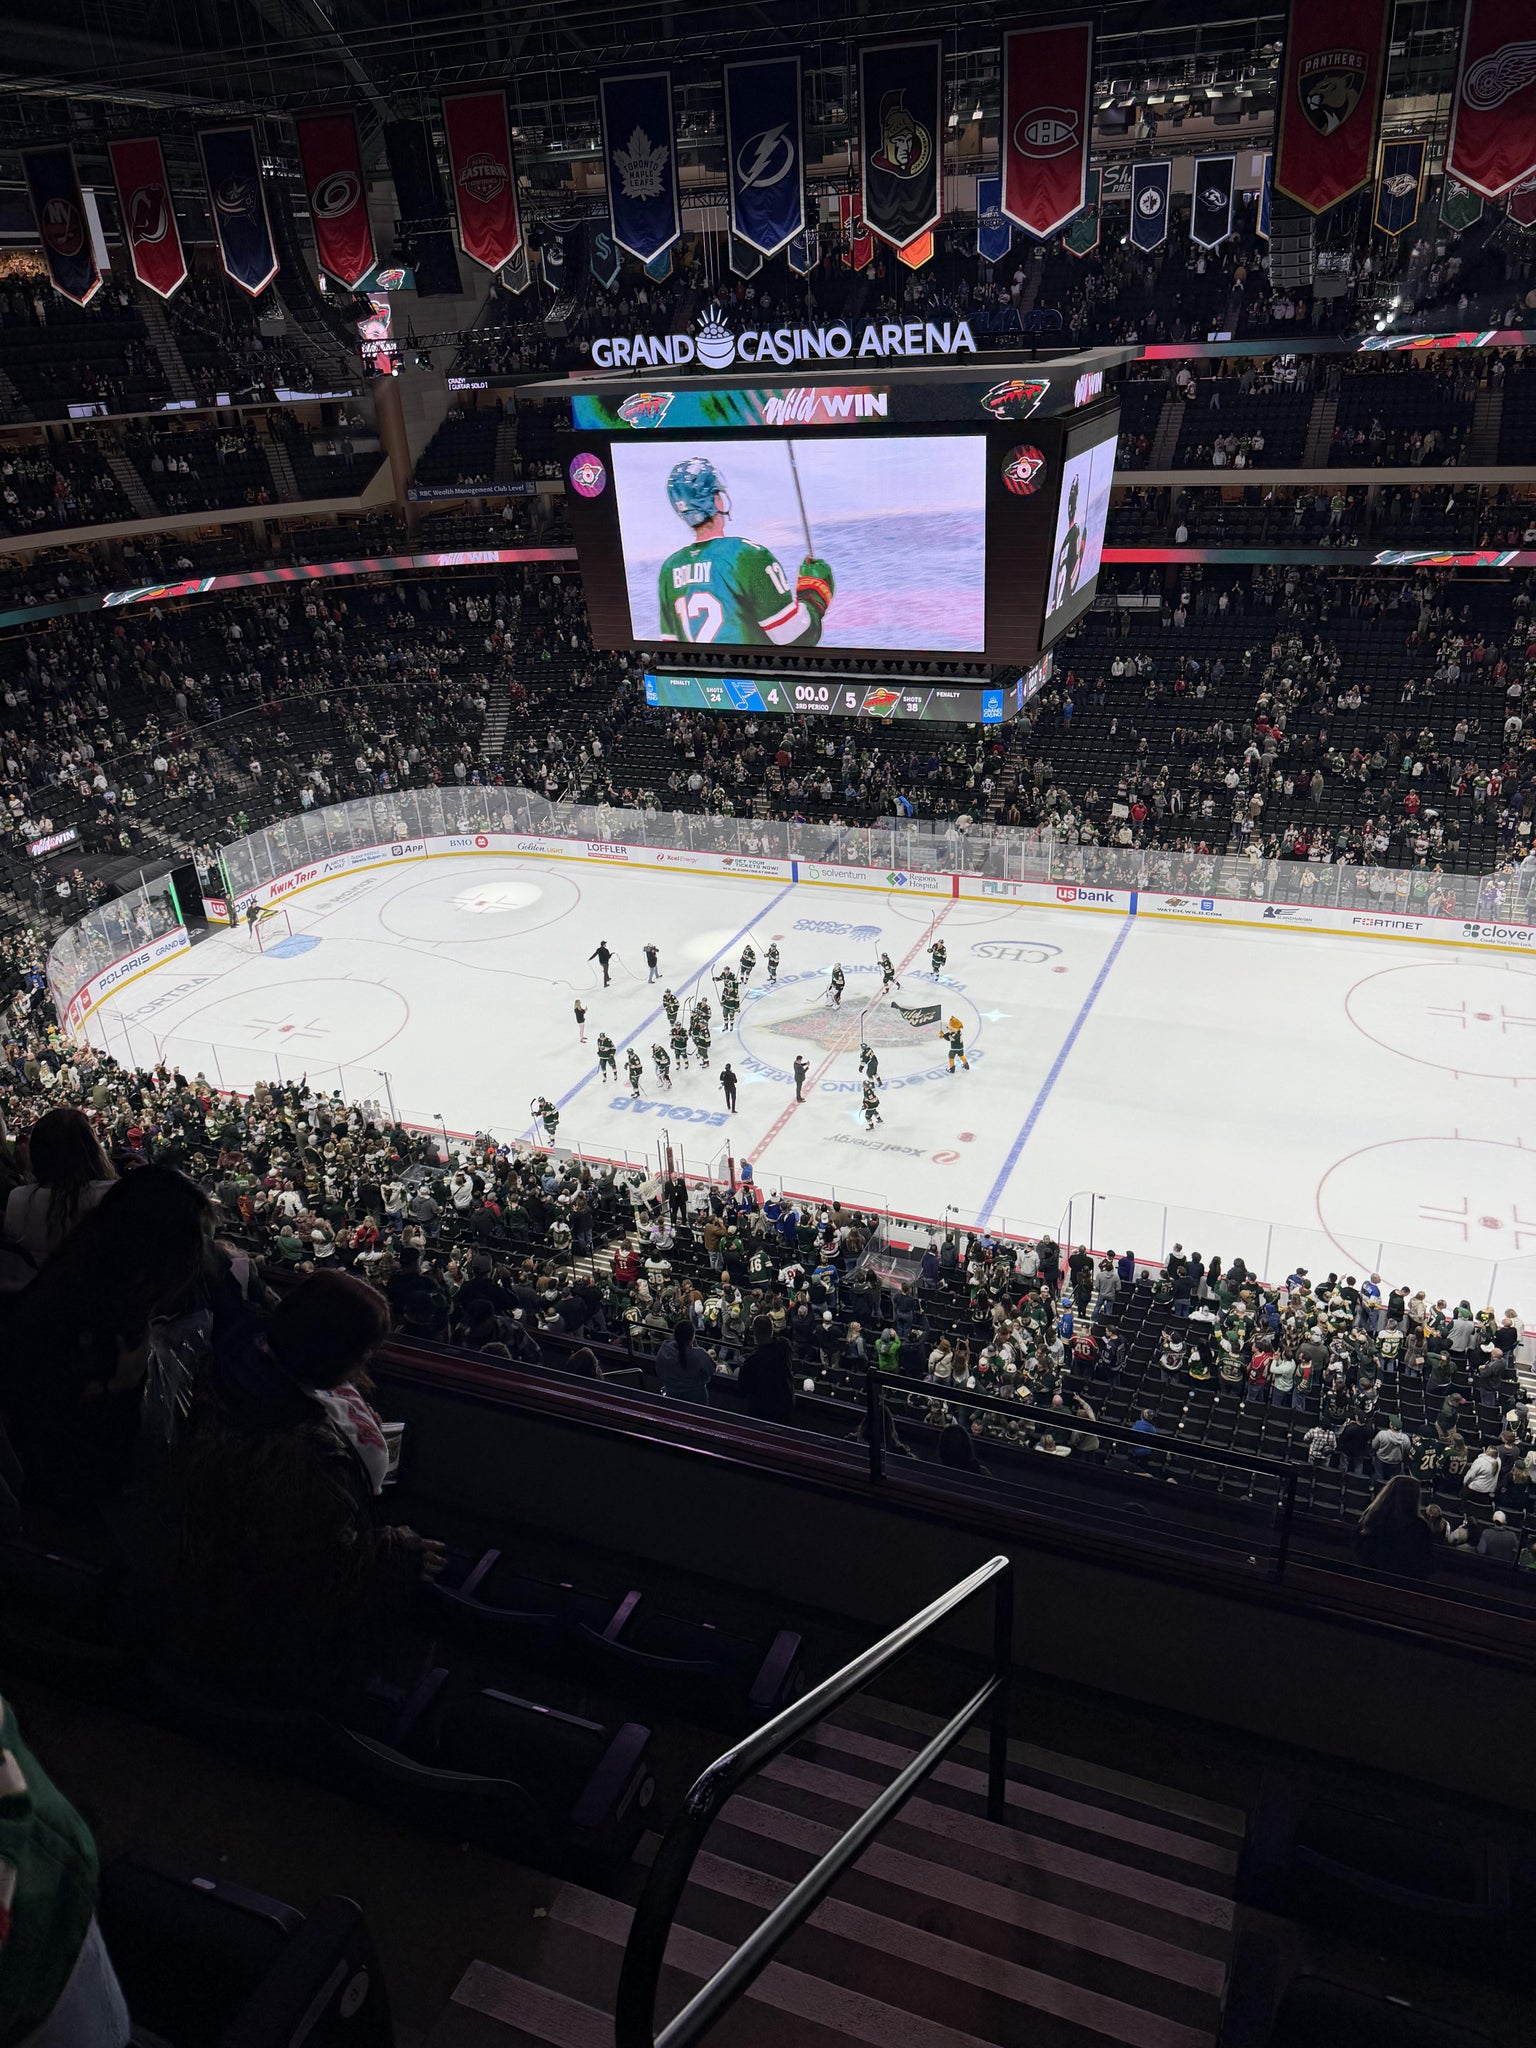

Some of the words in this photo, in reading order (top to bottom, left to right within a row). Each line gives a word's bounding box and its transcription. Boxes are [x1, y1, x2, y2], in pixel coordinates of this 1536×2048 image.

[1305, 53, 1362, 73] PANTHERS
[461, 164, 507, 179] EASTERN
[623, 160, 659, 172] TORONTO
[629, 170, 654, 178] MAPLE
[630, 179, 654, 187] LEAFS
[591, 334, 695, 368] GRAND
[737, 327, 852, 366] CASINO
[858, 321, 977, 356] ARENA
[821, 393, 888, 416] WIN
[432, 488, 454, 496] Wealth
[455, 487, 493, 496] Management
[467, 551, 499, 562] WIN
[674, 592, 723, 643] 12
[710, 694, 721, 702] 24
[767, 689, 779, 704] 4
[795, 686, 829, 702] 00.0
[845, 692, 857, 708] 5
[906, 703, 919, 712] 38
[54, 830, 75, 844] WIN
[450, 839, 472, 847] BMO
[518, 842, 545, 852] Golden
[587, 843, 628, 854] LOFFLER
[821, 868, 866, 880] solventum
[909, 873, 937, 882] Regions
[909, 881, 938, 889] Hospital
[1058, 889, 1074, 899] us
[1078, 889, 1114, 902] bank
[1157, 907, 1222, 917] WATCH.WILD.COM
[792, 924, 848, 935] GRAND
[797, 919, 852, 930] CASINO
[1352, 917, 1423, 931] FORTINET
[1482, 926, 1534, 941] clover
[976, 945, 1050, 964] CHS
[99, 953, 150, 990] POLARIS
[155, 940, 178, 956] GRAND
[608, 1097, 730, 1127] ECOLAB
[1074, 1344, 1091, 1356] 40
[1382, 1343, 1398, 1354] 97
[1448, 1461, 1466, 1475] 97
